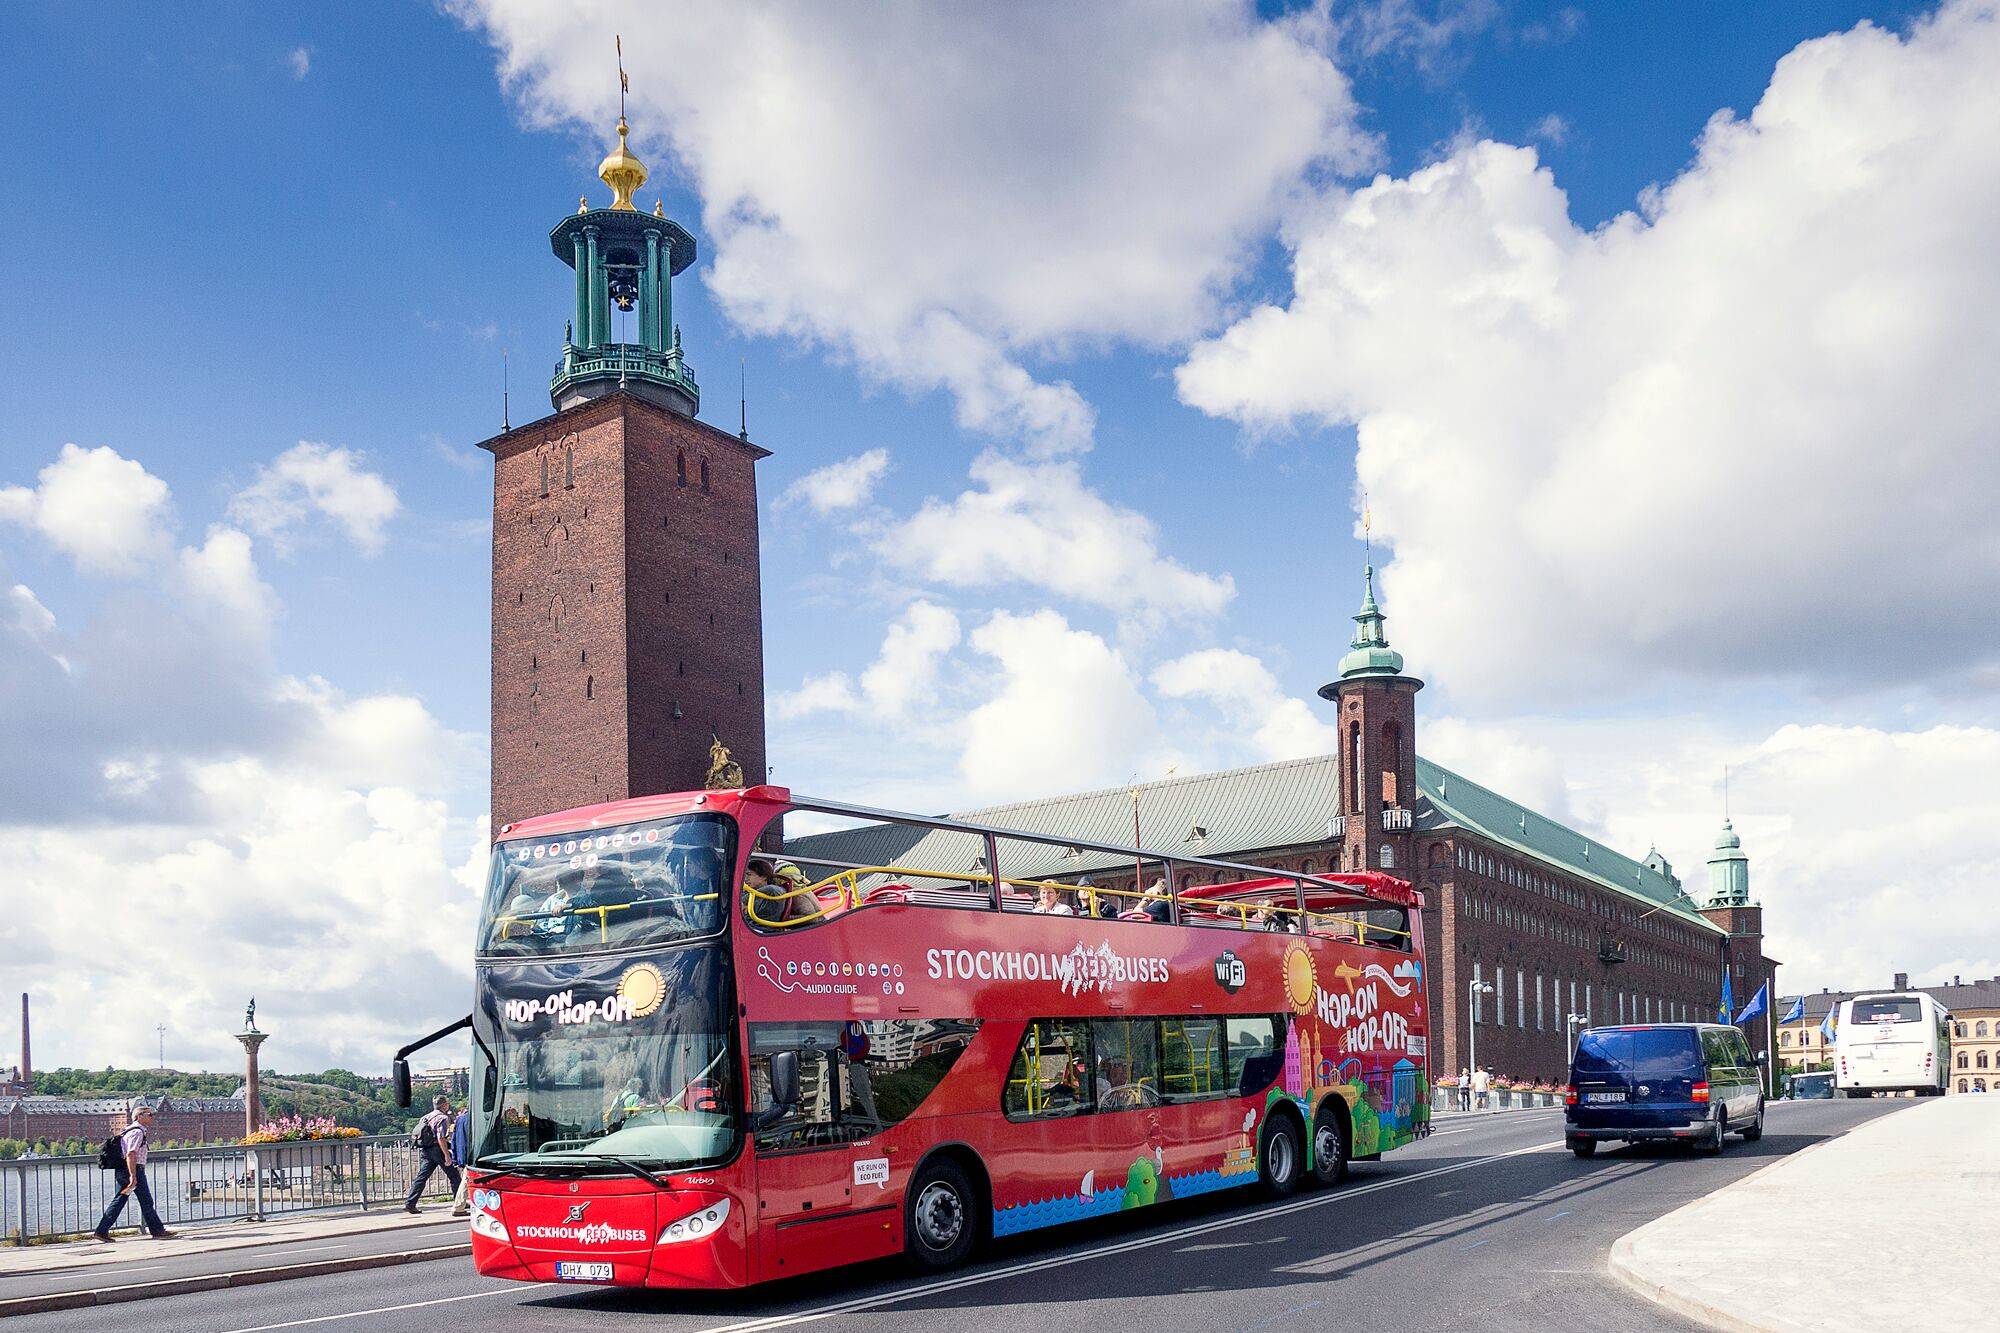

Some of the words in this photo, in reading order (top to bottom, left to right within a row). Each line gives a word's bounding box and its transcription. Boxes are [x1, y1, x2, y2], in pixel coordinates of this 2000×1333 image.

[926, 948, 1068, 981] STOCKHOLM
[1115, 957, 1169, 983] BUSES
[806, 984, 832, 994] AUDIO
[834, 984, 858, 994] GUIDE
[505, 989, 573, 1023] HOP-ON
[558, 996, 636, 1025] HOP-OFF
[1317, 981, 1378, 1028] HOP-ON
[1346, 1010, 1407, 1053] HOP-OFF
[860, 1173, 871, 1181] ECO
[516, 1225, 583, 1239] STOCKHOLM
[611, 1228, 647, 1241] BUSES
[562, 1264, 582, 1276] DHX
[590, 1264, 610, 1277] 079
